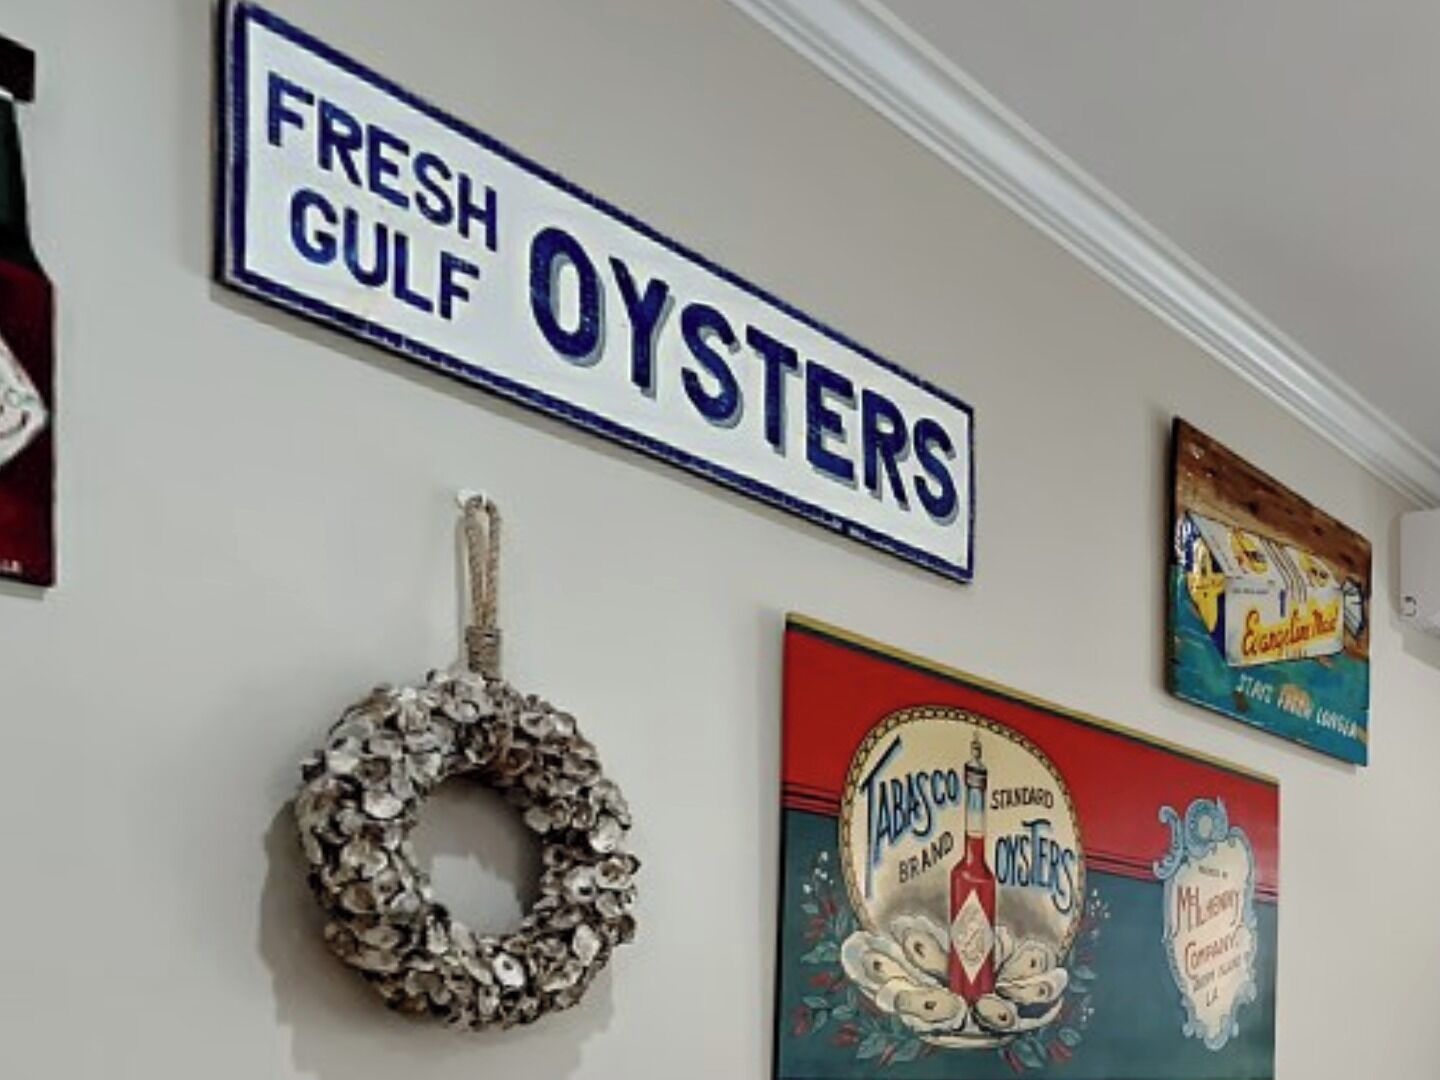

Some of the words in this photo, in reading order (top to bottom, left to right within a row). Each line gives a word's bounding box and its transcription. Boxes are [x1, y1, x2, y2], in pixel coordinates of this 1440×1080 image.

[266, 69, 498, 253] FRESH
[289, 186, 481, 321] GULF
[529, 226, 959, 526] OYSTERS
[858, 733, 962, 900] TABASCO
[898, 830, 955, 885] BRAND
[991, 786, 1055, 811] STANDARD
[994, 816, 1075, 914] OYSTERS
